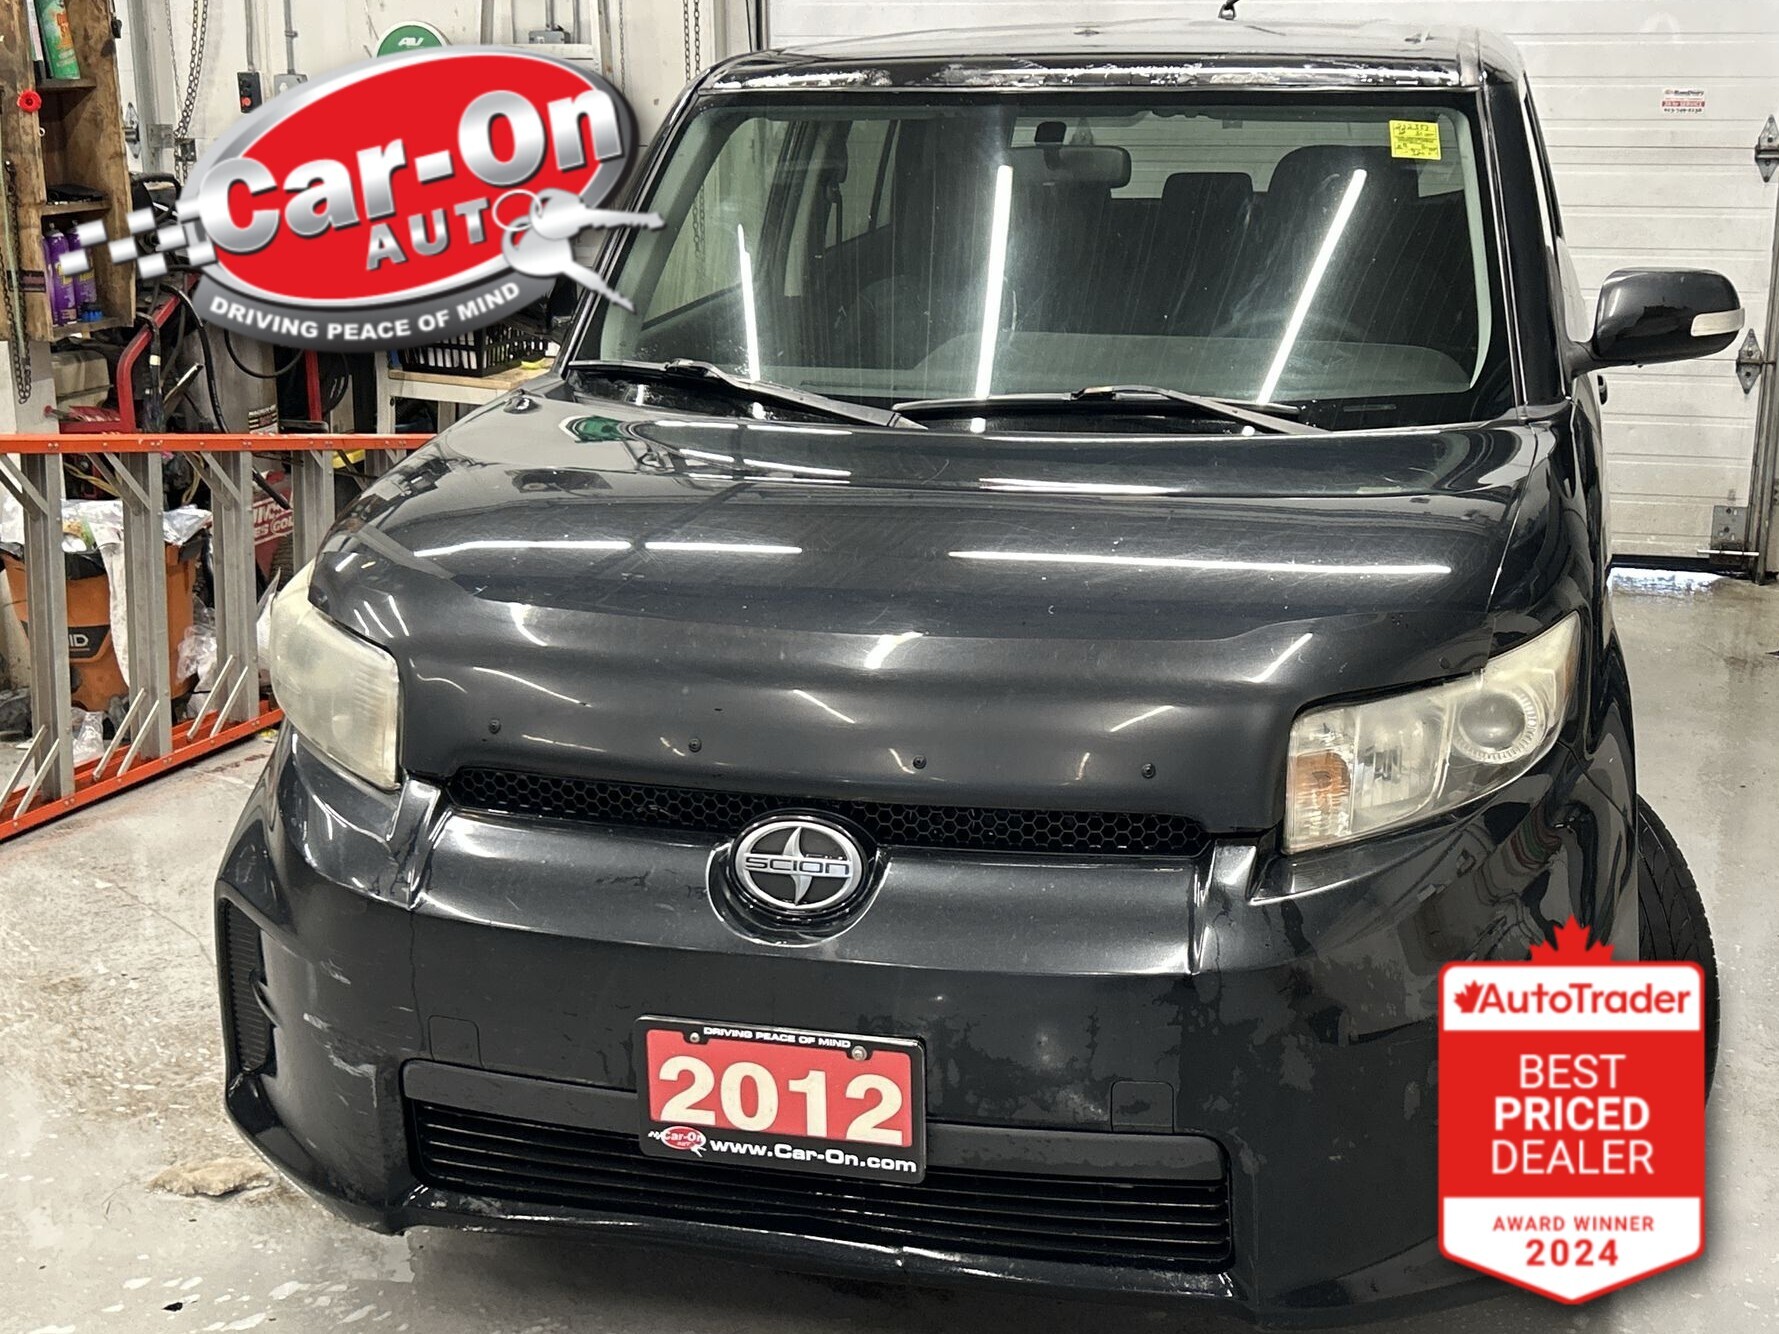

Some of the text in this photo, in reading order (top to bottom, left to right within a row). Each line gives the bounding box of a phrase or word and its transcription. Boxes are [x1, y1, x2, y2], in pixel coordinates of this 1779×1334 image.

[703, 1027, 851, 1049] DRIVING PEACE OF MIND
[658, 1055, 903, 1146] 2012
[710, 1139, 917, 1173] www.Car-On.com
